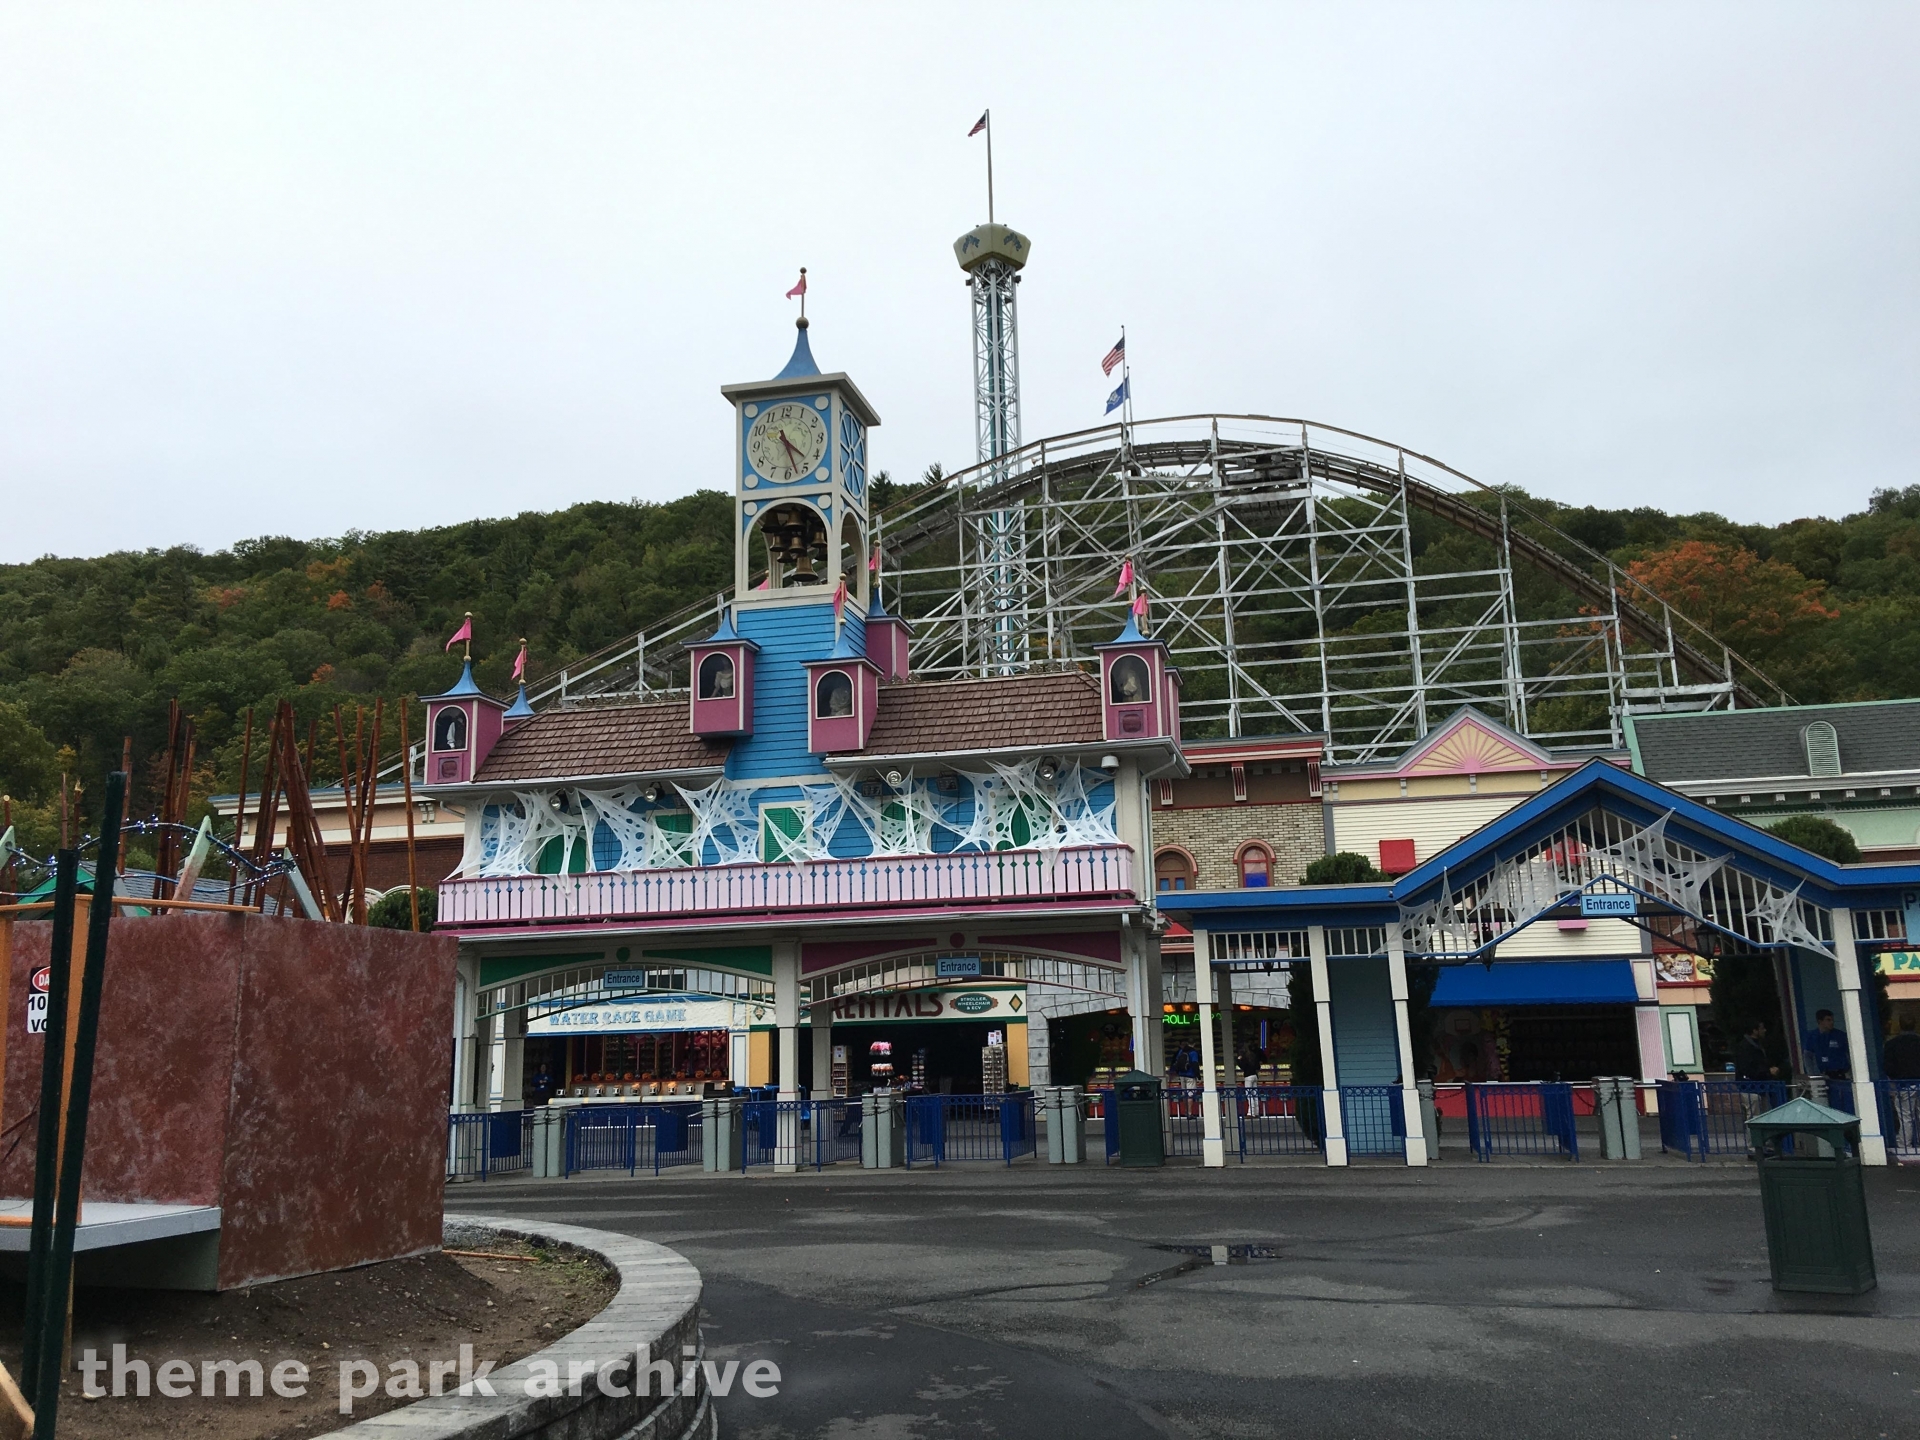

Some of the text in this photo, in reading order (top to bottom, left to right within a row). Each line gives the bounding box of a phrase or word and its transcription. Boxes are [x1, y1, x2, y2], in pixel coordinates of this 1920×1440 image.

[766, 412, 775, 423] 11
[781, 405, 792, 418] 12
[800, 407, 805, 419] 1
[811, 416, 818, 428] 2
[754, 424, 766, 437] 10
[816, 432, 824, 444] 3
[752, 441, 760, 453] 9
[813, 448, 820, 460] 4
[757, 456, 765, 468] 8
[801, 462, 809, 474] 5
[770, 466, 776, 478] 7
[784, 467, 792, 480] 6
[1586, 898, 1630, 910] Entrance
[940, 961, 976, 972] Entrance
[607, 973, 640, 984] Entrance
[550, 1008, 687, 1026] WATER RACE GAME
